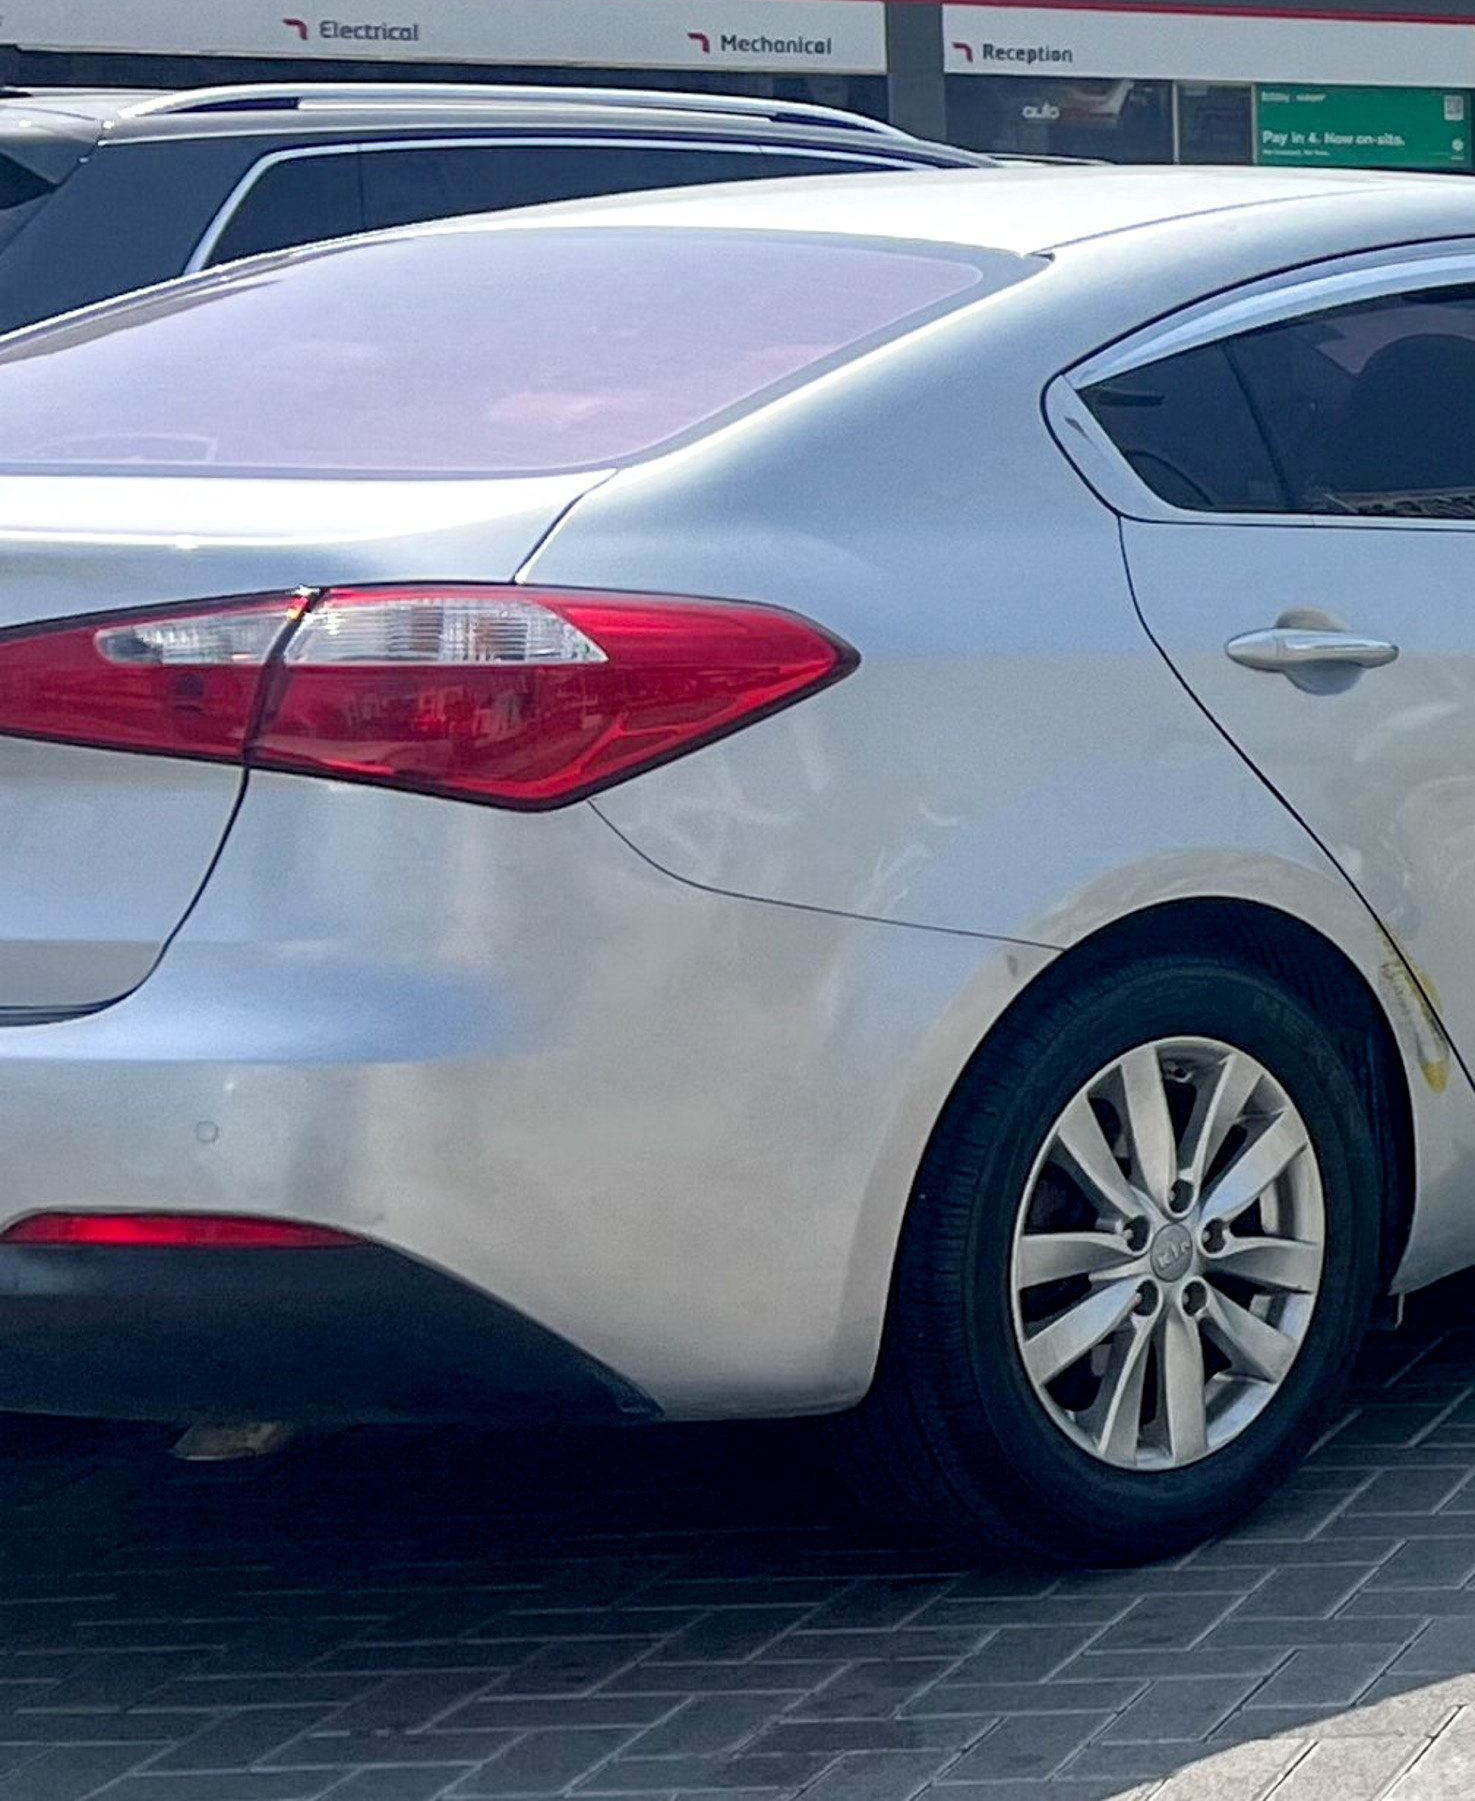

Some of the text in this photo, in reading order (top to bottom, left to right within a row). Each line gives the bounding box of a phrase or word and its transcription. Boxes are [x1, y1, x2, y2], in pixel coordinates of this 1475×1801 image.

[319, 19, 419, 41] Electrical
[720, 34, 832, 55] Mechanical
[982, 43, 1073, 65] Reception
[1262, 130, 1288, 146] Pay
[1291, 131, 1305, 144] in
[1324, 132, 1353, 145] Now
